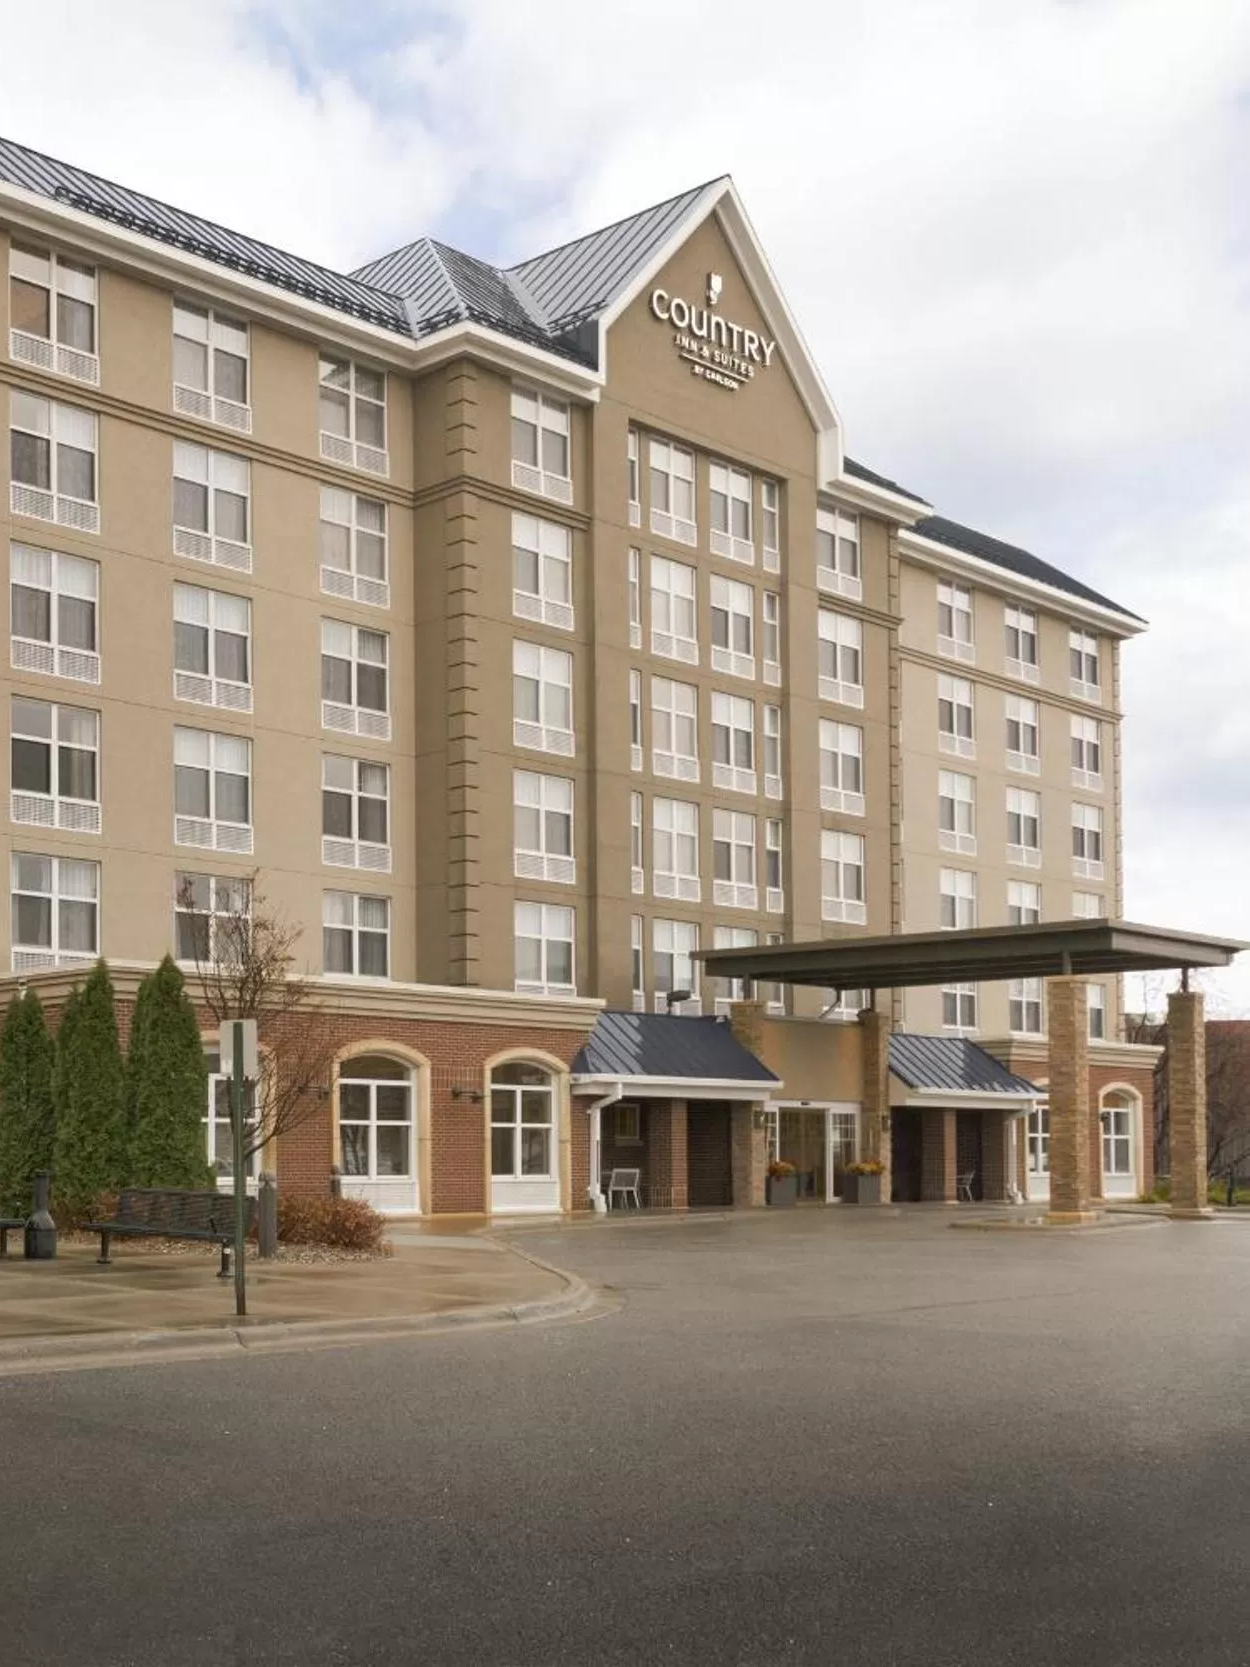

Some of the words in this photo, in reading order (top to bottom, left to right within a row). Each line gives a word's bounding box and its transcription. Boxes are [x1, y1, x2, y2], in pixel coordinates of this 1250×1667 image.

[674, 332, 698, 353] INN
[714, 350, 755, 377] SUITES
[705, 368, 739, 389] CARLSON
